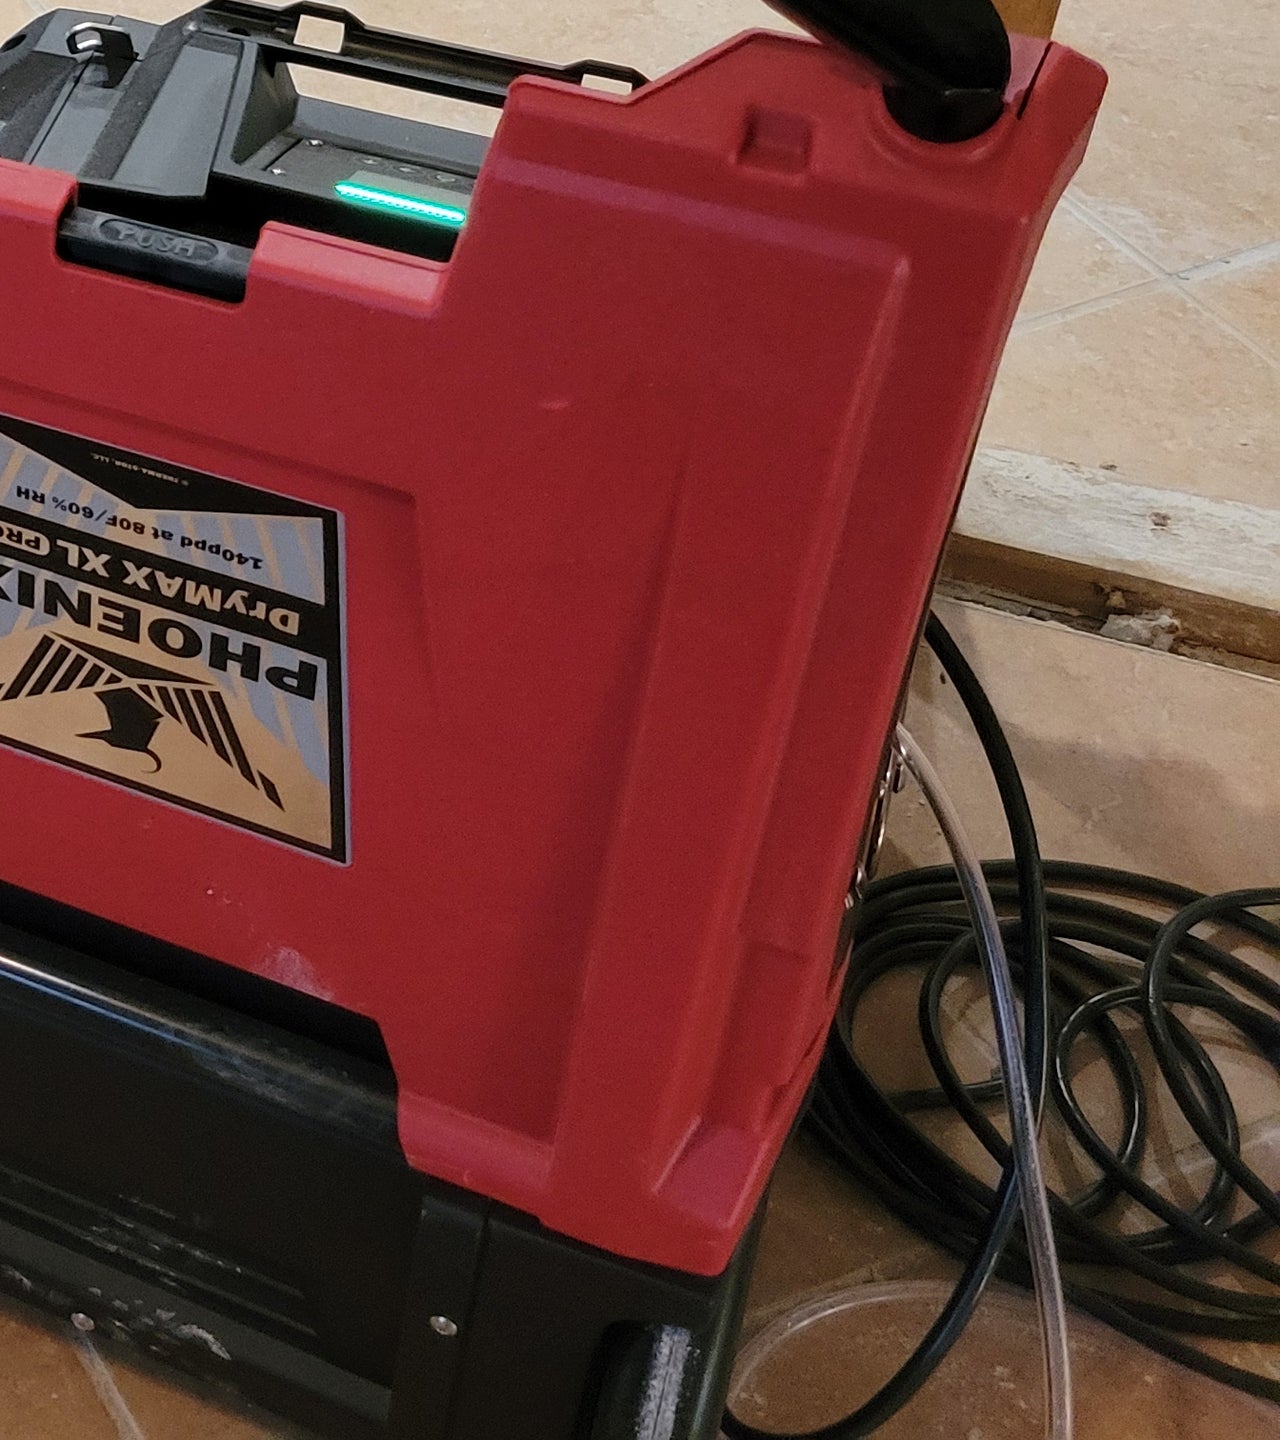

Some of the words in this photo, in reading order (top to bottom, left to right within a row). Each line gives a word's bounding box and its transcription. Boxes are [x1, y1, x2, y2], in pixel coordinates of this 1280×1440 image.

[117, 226, 196, 257] PUSH
[16, 485, 46, 505] RH
[52, 495, 146, 532] 80F/60%
[151, 526, 174, 541] at
[56, 538, 112, 578] XL
[180, 535, 263, 570] 140ppd
[121, 560, 300, 636] DryMAX
